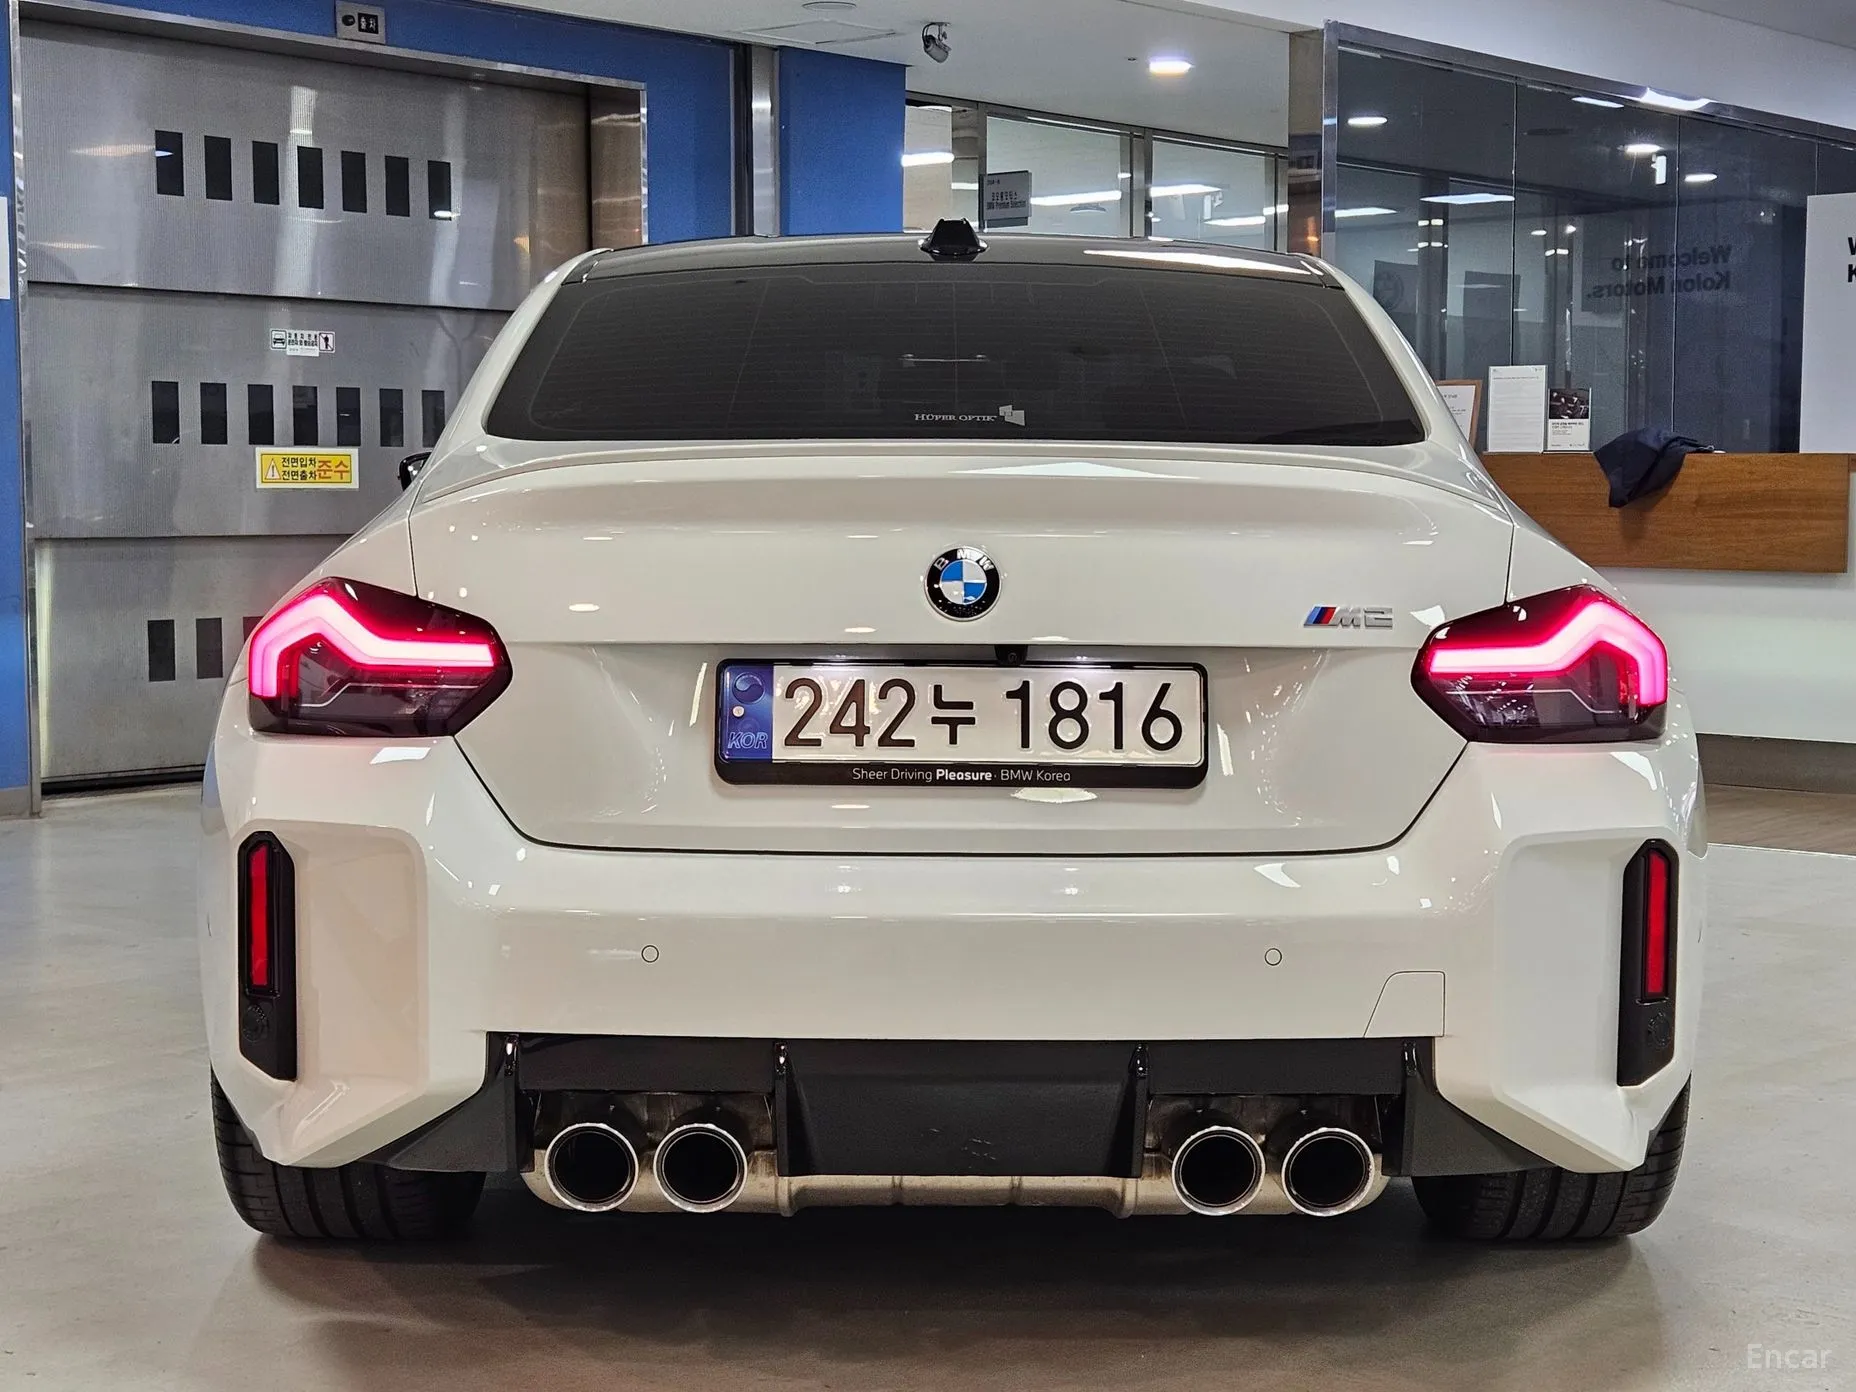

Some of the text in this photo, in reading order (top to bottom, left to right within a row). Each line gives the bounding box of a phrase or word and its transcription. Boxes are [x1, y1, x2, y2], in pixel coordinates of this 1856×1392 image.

[281, 457, 317, 468] 전면입차
[317, 459, 350, 480] 준수
[281, 470, 317, 481] 전면출차
[934, 548, 995, 572] BMW
[1322, 606, 1392, 629] M2
[1005, 680, 1183, 751] 1816
[727, 731, 768, 749] KOR
[852, 768, 1071, 782] Sheer Driving Pleasure BMW Korea
